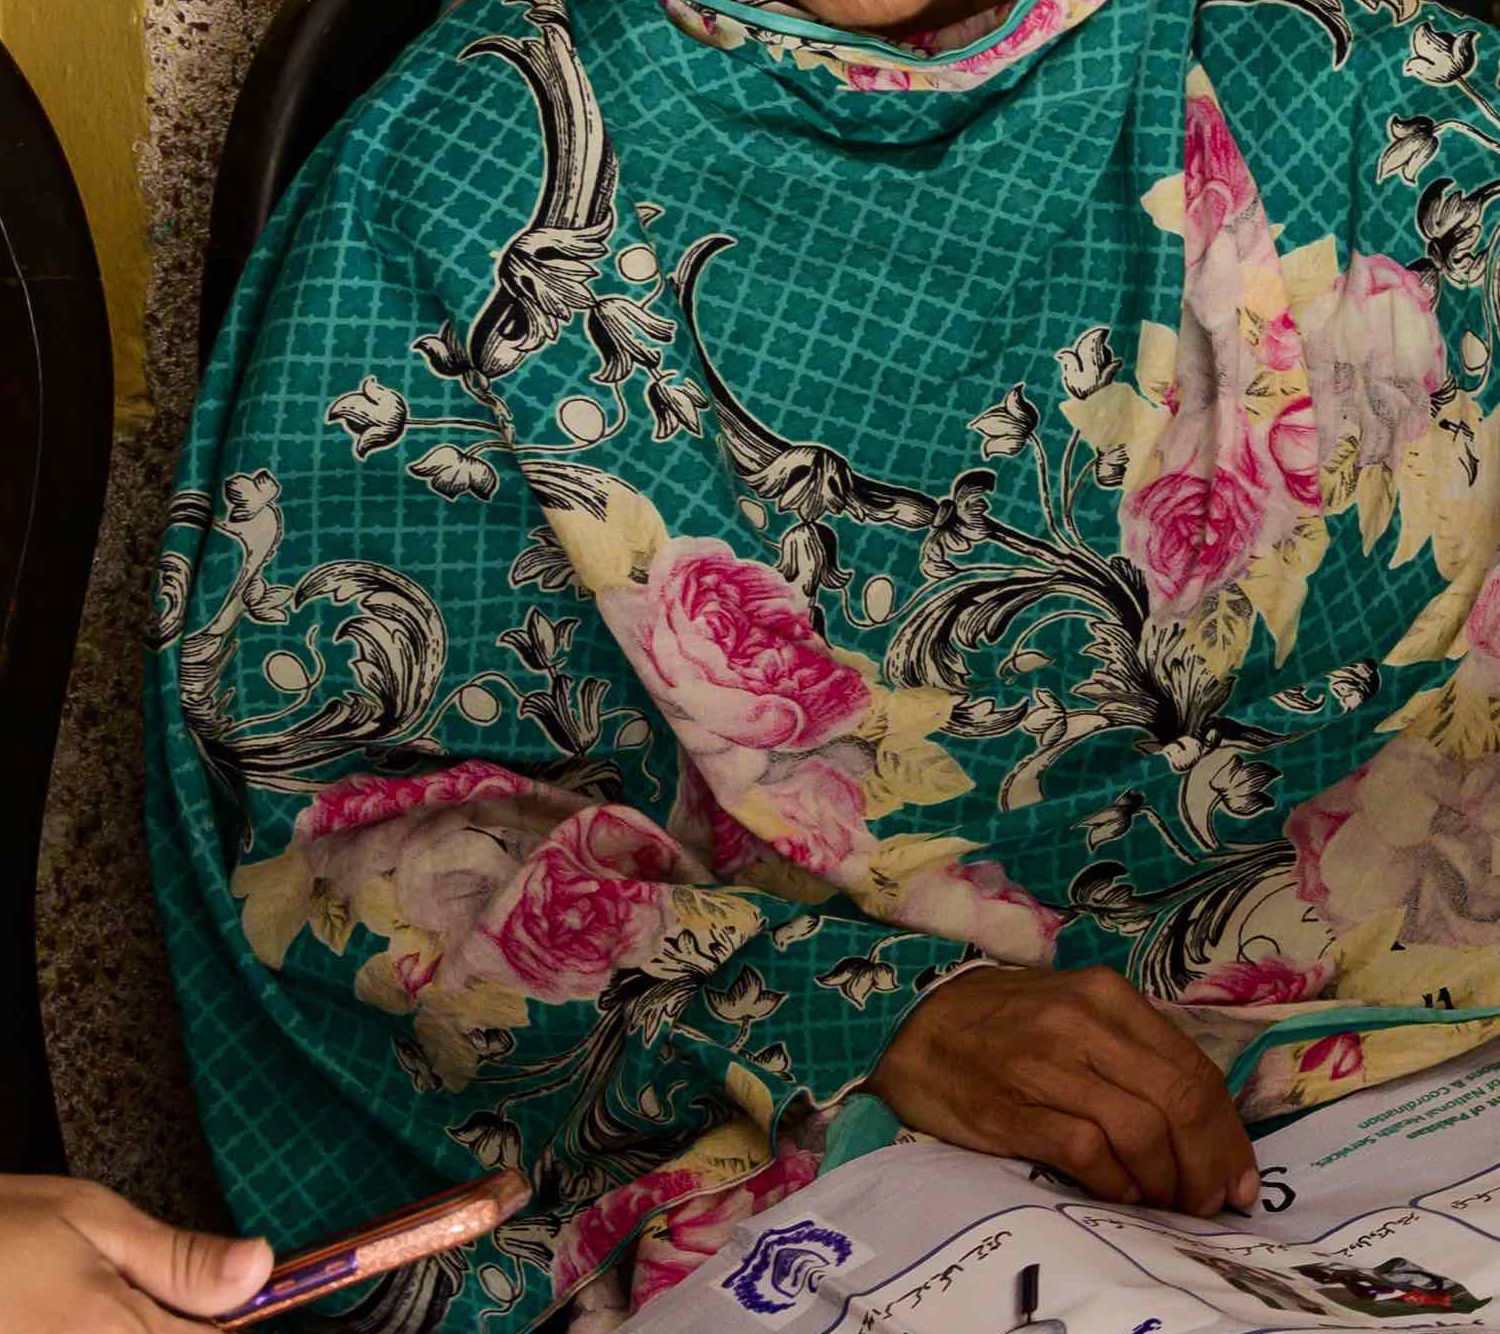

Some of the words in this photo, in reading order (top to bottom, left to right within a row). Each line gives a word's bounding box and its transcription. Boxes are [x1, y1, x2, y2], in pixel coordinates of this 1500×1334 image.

[1486, 1078, 1500, 1092] of
[1356, 1086, 1451, 1131] Coordination
[1424, 1087, 1486, 1118] National
[1470, 1104, 1486, 1117] of
[1376, 1113, 1425, 1138] Health
[1406, 1111, 1470, 1140] Pakistan
